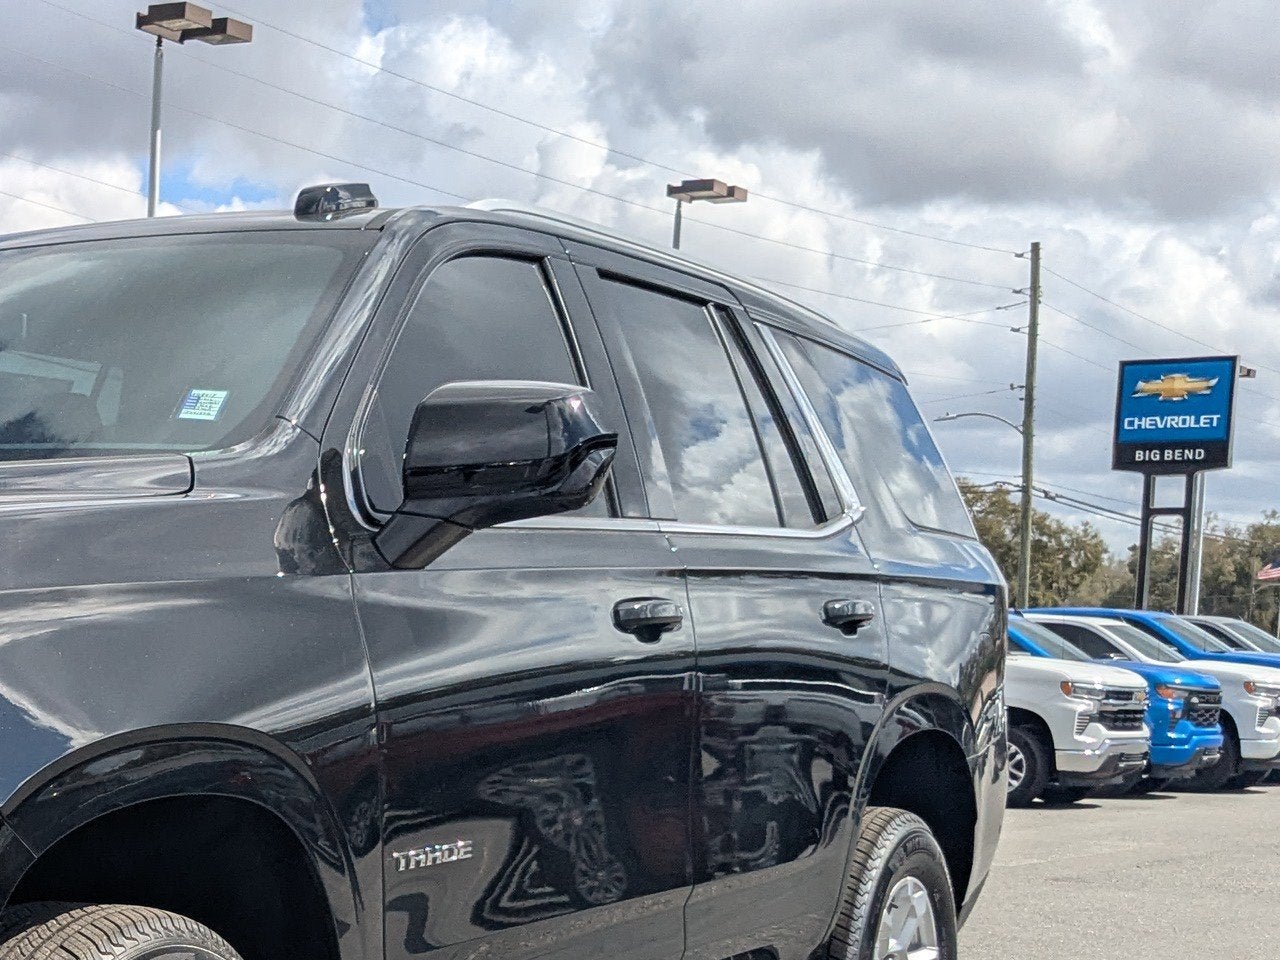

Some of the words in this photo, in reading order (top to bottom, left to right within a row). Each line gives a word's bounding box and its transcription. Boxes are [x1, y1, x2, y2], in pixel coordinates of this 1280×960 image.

[1123, 415, 1221, 430] CHEVROLET
[1135, 450, 1160, 461] BIG
[1164, 449, 1205, 460] BEND
[392, 841, 473, 872] TAHOE
